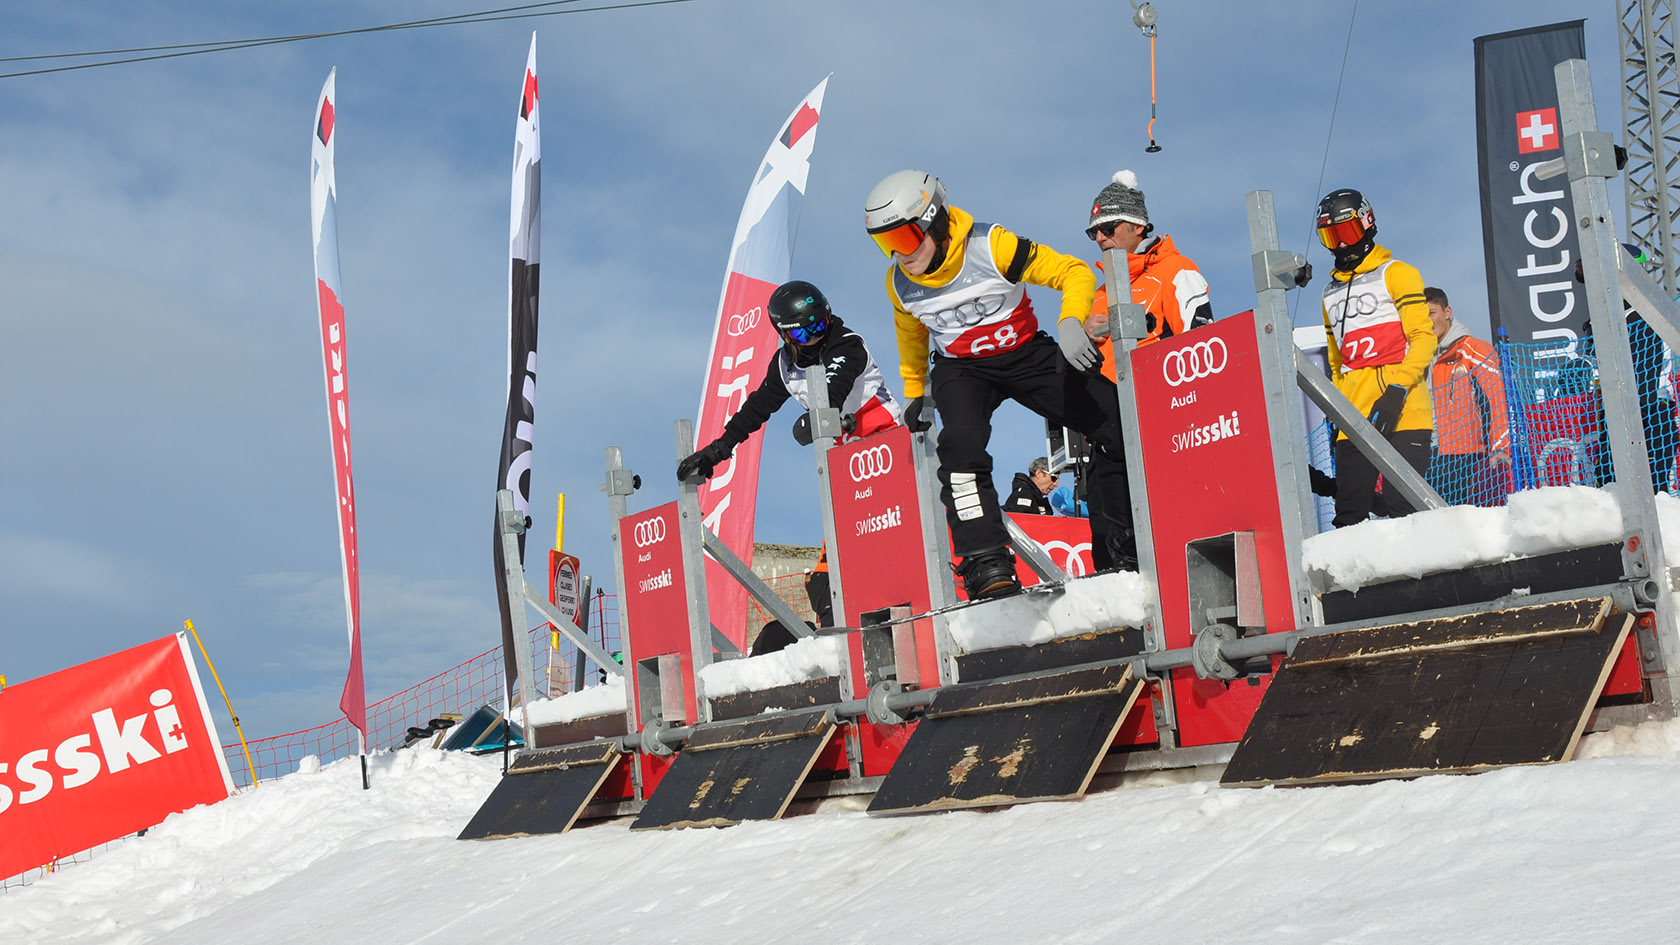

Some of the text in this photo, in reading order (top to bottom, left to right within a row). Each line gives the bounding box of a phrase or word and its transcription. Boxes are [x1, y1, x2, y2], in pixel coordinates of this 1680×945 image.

[1512, 161, 1580, 404] watch
[970, 324, 1018, 356] 68
[1345, 336, 1378, 360] 72
[1170, 390, 1197, 410] Audi
[1171, 410, 1240, 453] swissski
[854, 486, 873, 501] Audi
[855, 505, 902, 537] swissski
[638, 551, 652, 563] Audi
[638, 568, 673, 594] swissski
